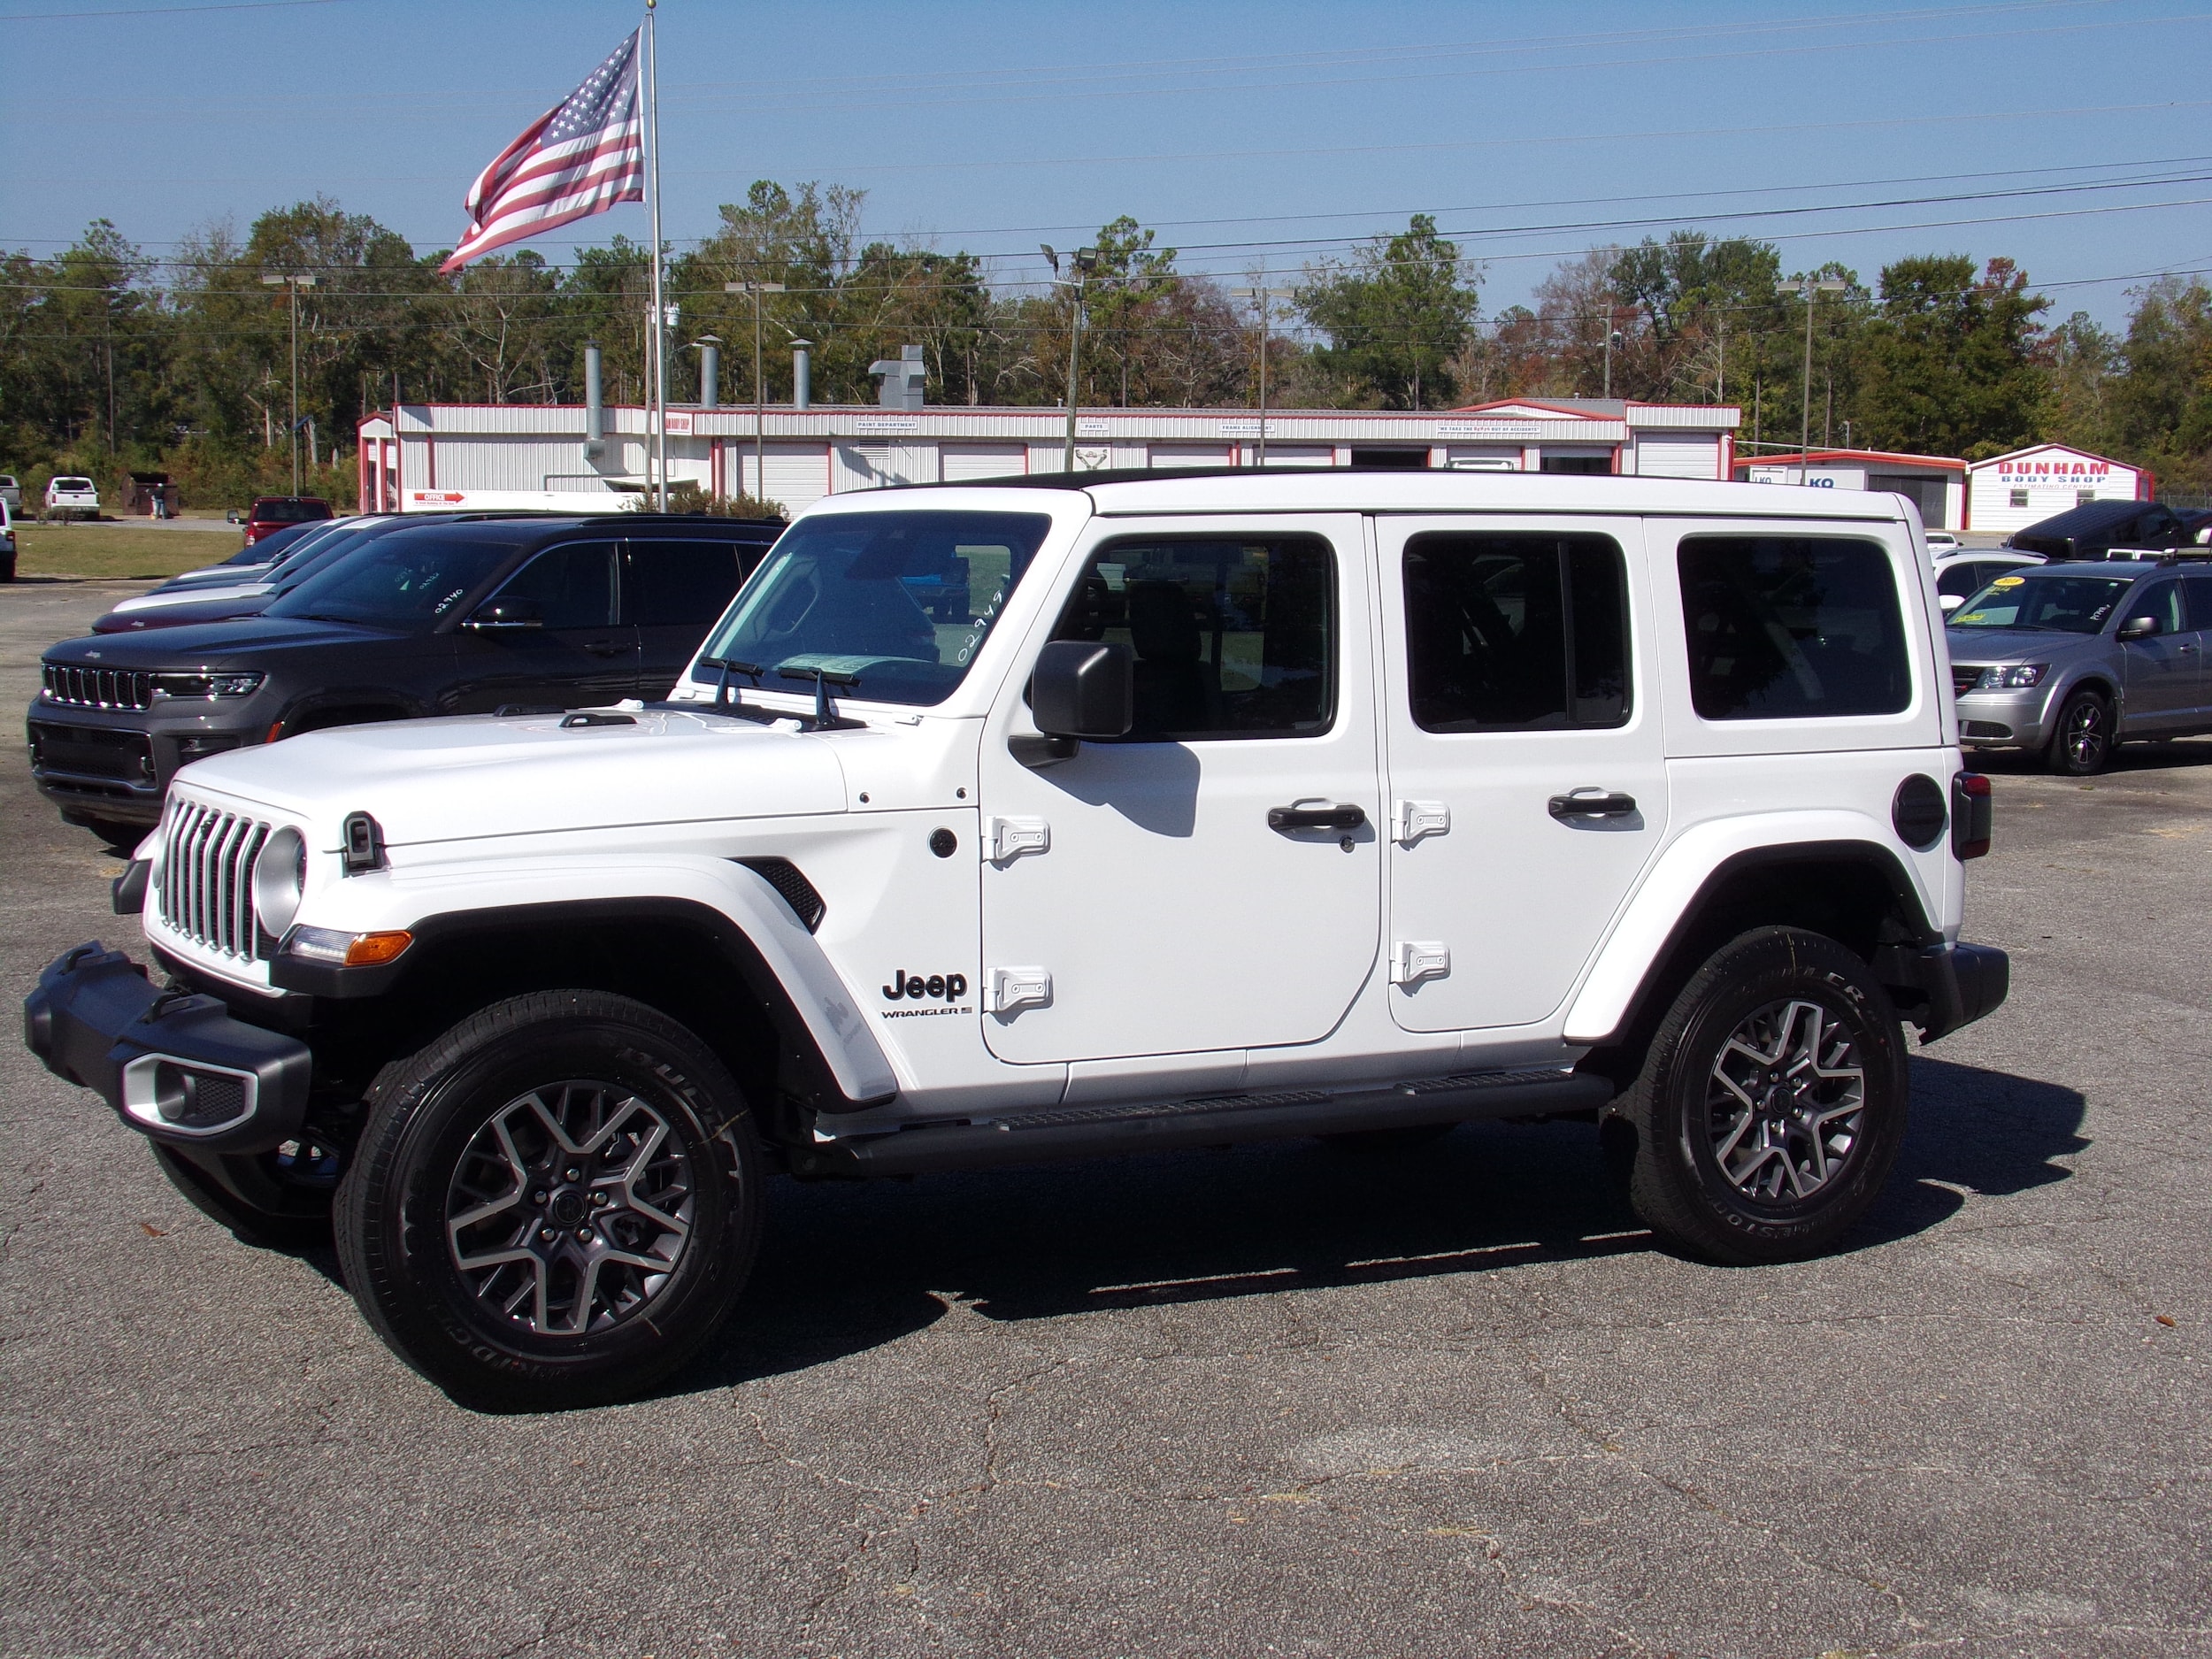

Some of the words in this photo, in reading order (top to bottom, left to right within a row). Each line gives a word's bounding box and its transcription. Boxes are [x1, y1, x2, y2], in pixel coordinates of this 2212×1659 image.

[1998, 461, 2110, 474] DUNHAM
[434, 588, 464, 614] 02940
[957, 589, 1002, 662] 02949
[882, 969, 968, 1002] Jeep
[881, 1007, 958, 1018] WRANGLER
